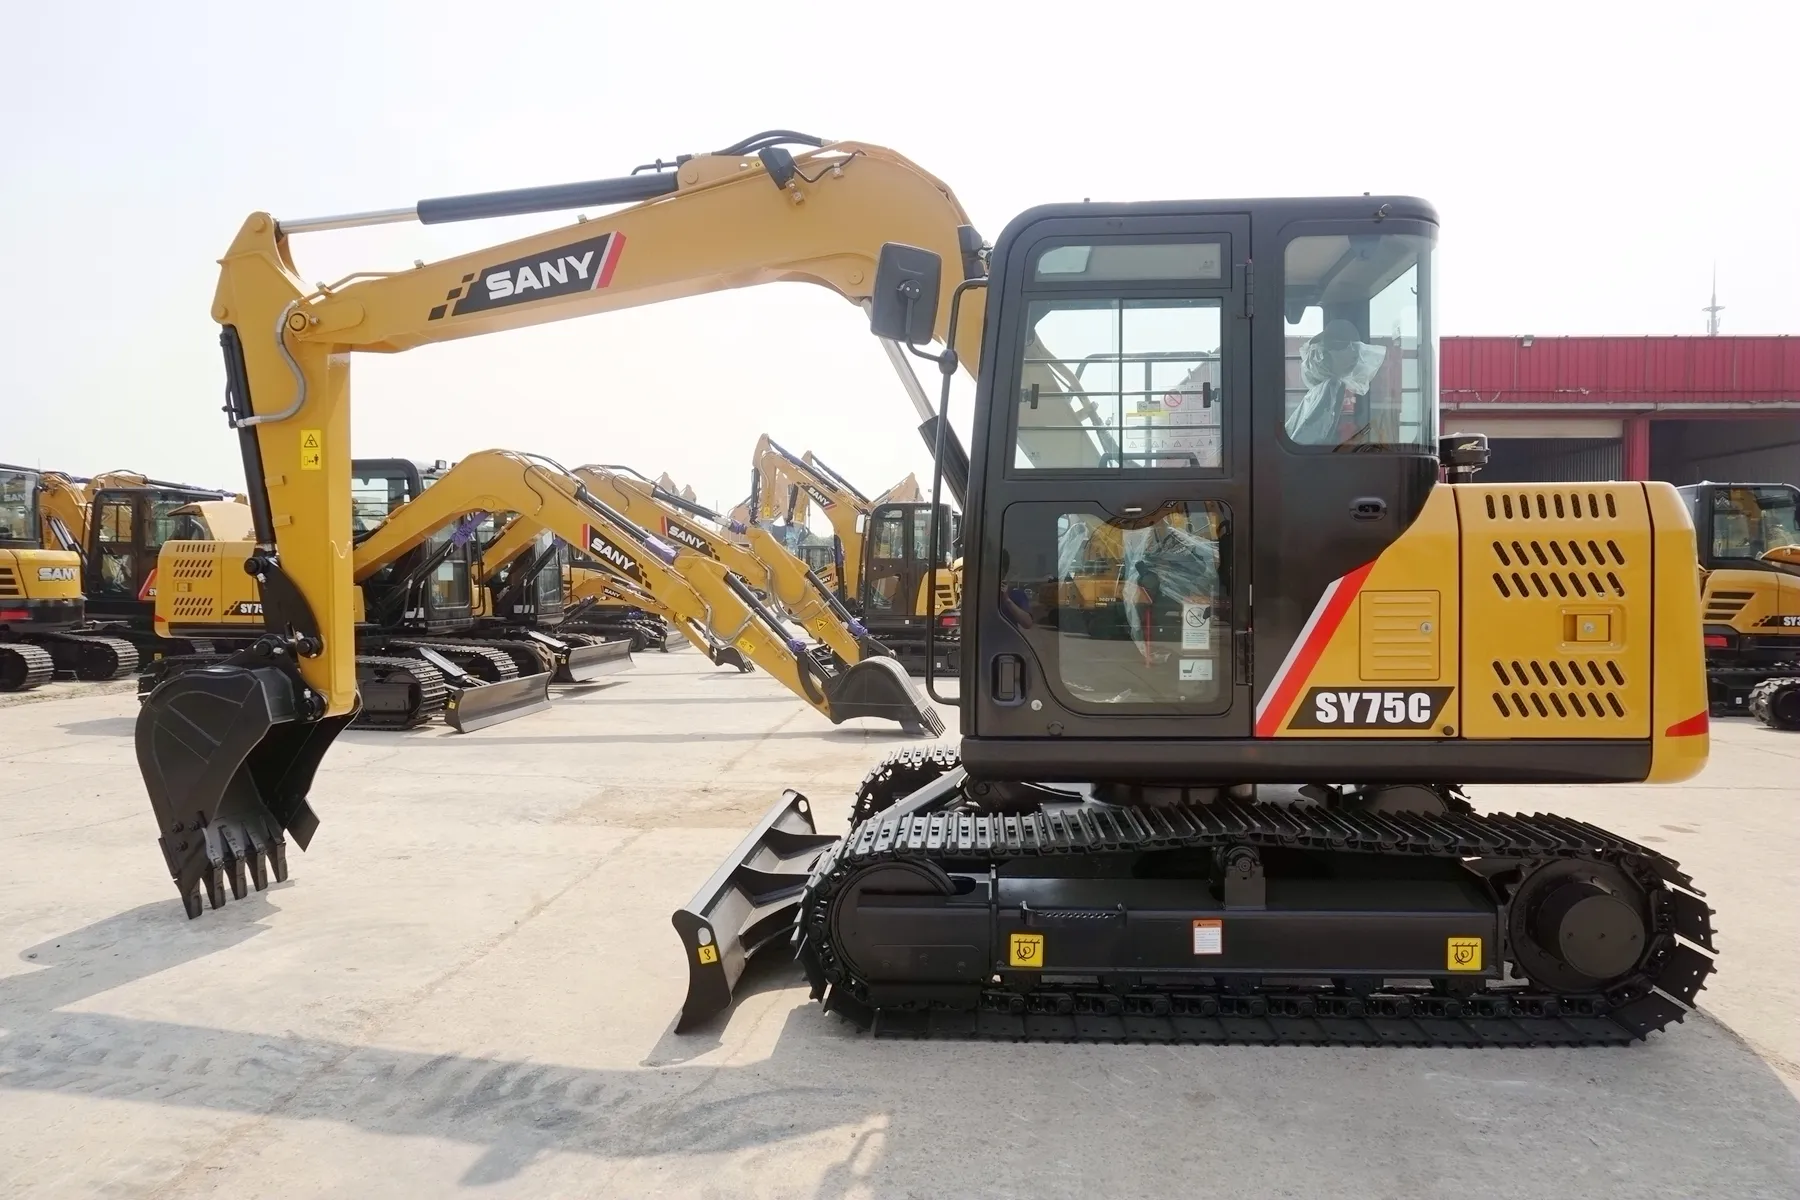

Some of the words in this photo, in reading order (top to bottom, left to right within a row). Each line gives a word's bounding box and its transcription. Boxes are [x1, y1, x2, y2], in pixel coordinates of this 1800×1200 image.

[486, 250, 594, 300] SANY
[4, 493, 26, 502] SAN
[808, 487, 830, 506] SANY
[668, 525, 706, 549] SANY
[591, 537, 635, 571] SANY
[39, 567, 77, 580] SANY
[604, 588, 621, 598] SANY
[1316, 692, 1431, 723] SY75C
